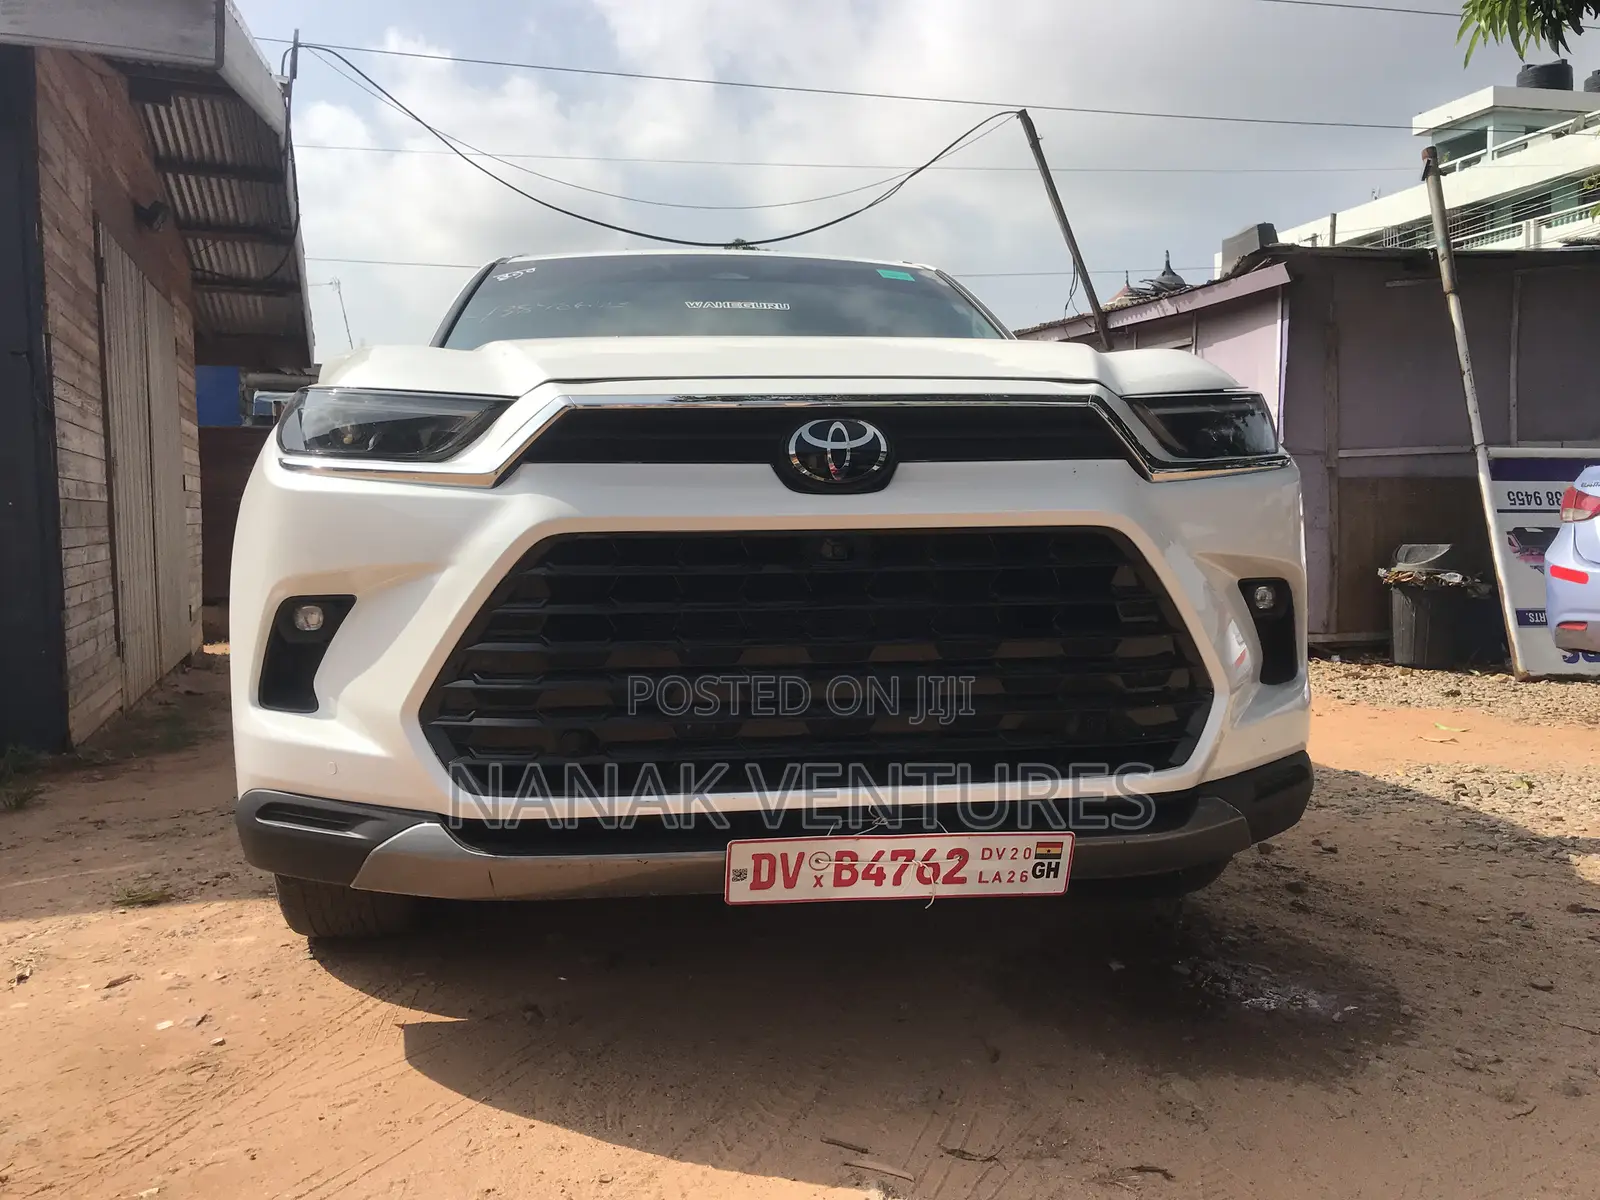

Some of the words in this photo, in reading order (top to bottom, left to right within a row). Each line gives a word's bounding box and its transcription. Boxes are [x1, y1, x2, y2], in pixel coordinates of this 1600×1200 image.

[684, 301, 791, 311] WAHEGURU
[1507, 491, 1543, 506] 9455
[1526, 612, 1547, 623] RTS.
[750, 852, 806, 891] DV
[832, 847, 970, 888] B4762
[1031, 861, 1061, 880] GH
